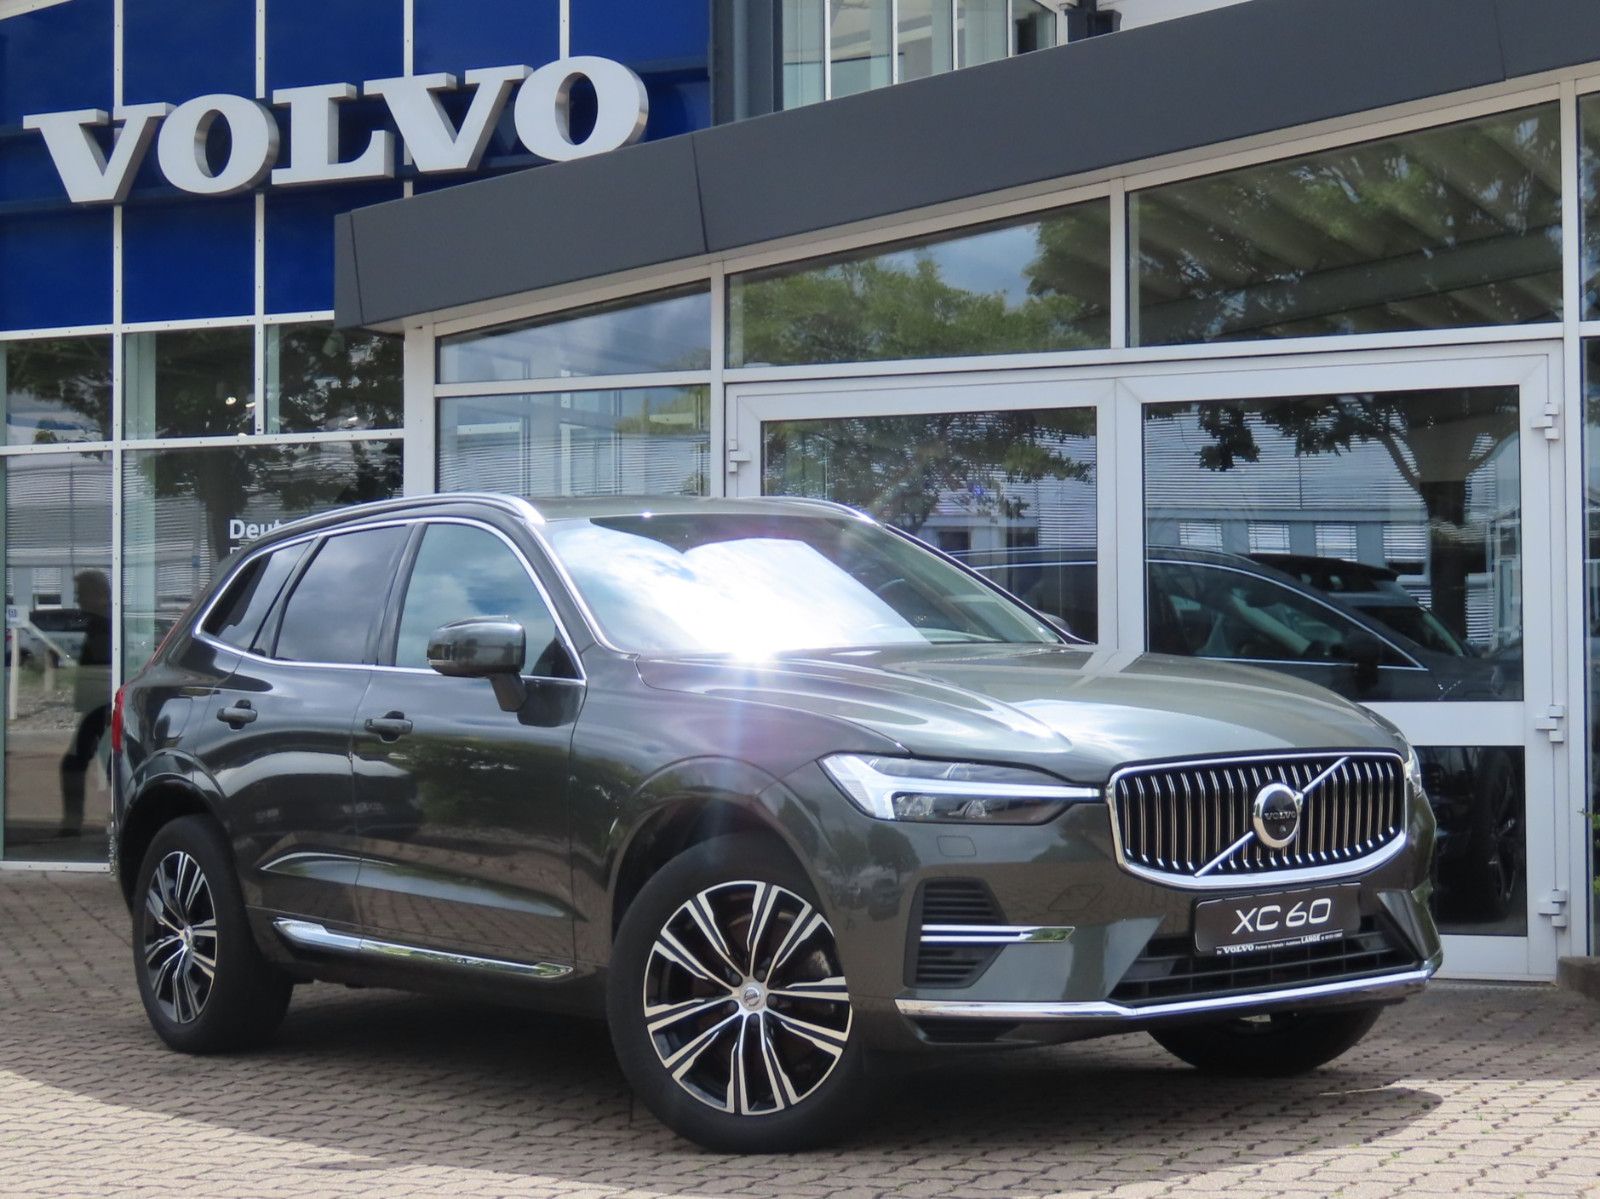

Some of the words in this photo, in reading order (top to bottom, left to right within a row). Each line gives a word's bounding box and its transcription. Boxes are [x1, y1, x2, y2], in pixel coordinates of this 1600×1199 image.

[22, 56, 649, 203] VOLVO
[1264, 811, 1297, 820] VOLVO
[1222, 944, 1254, 954] VOLVO
